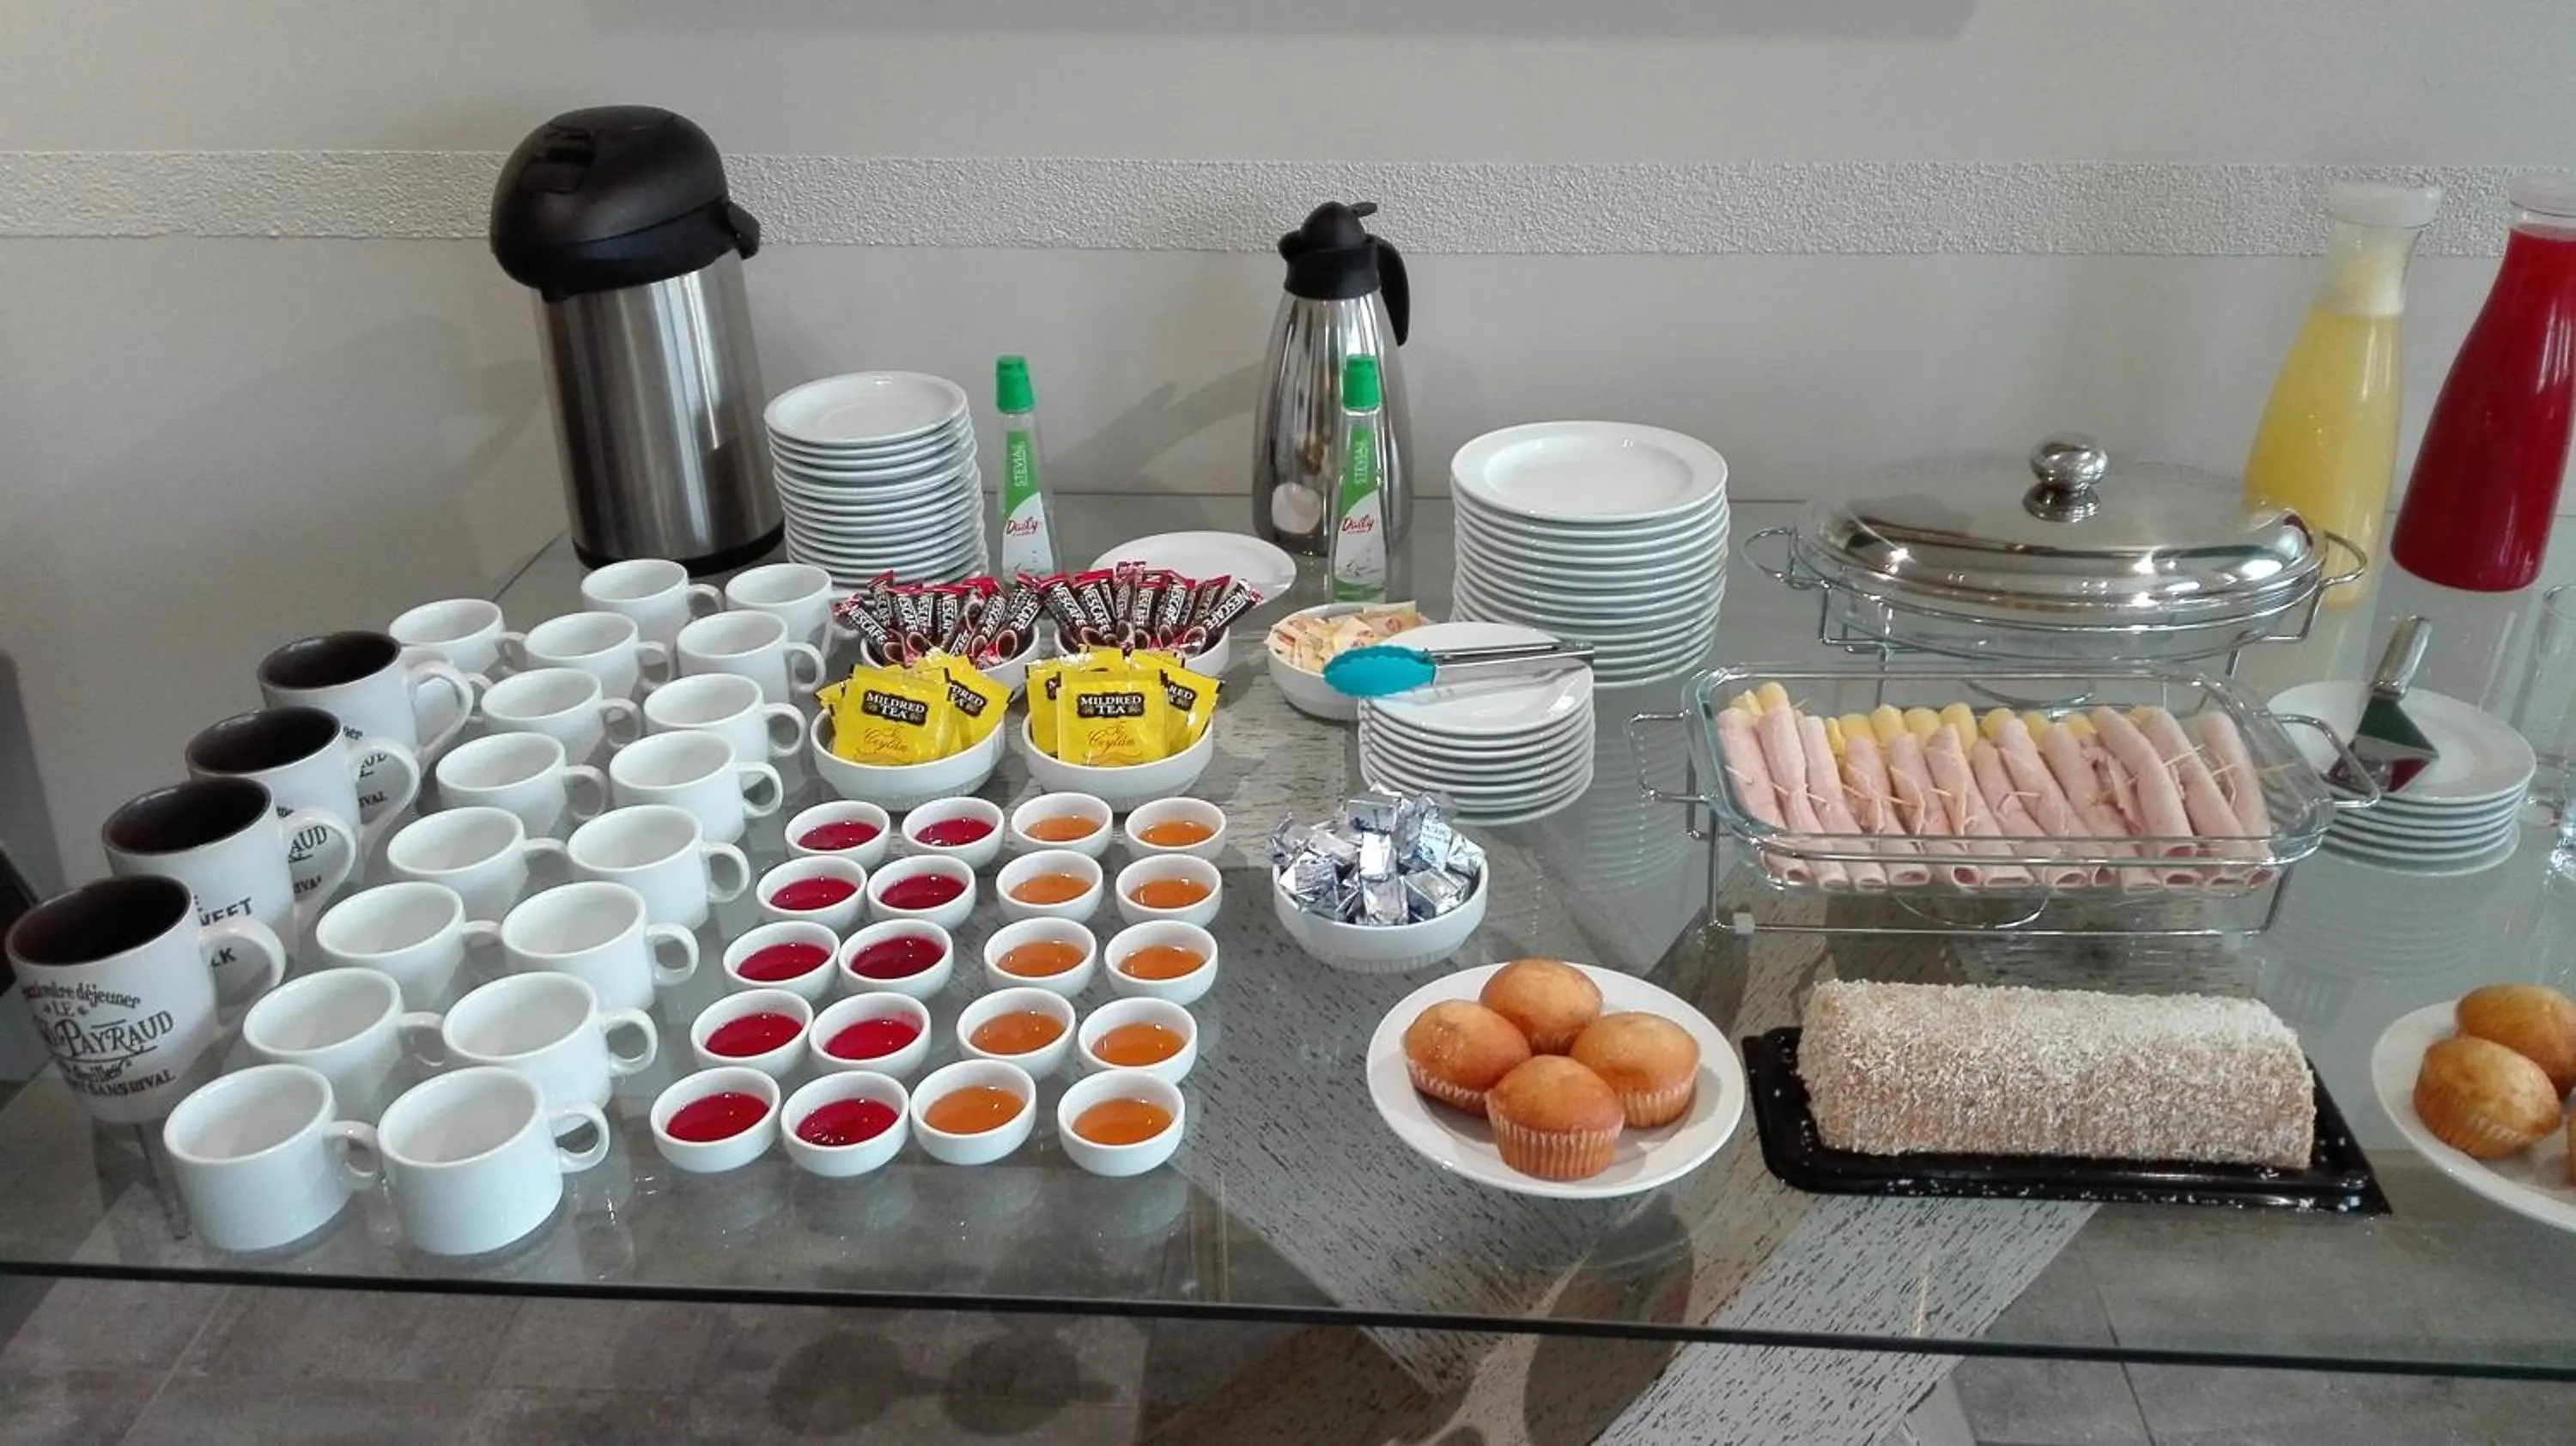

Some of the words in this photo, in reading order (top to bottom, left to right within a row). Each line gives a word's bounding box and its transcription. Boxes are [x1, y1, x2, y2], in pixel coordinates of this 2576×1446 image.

[866, 691, 926, 714] MILDRED
[1080, 696, 1142, 705] MILDRED
[879, 703, 909, 720] TEA
[1096, 705, 1126, 714] TEA
[54, 1011, 173, 1057] PAYRAUD
